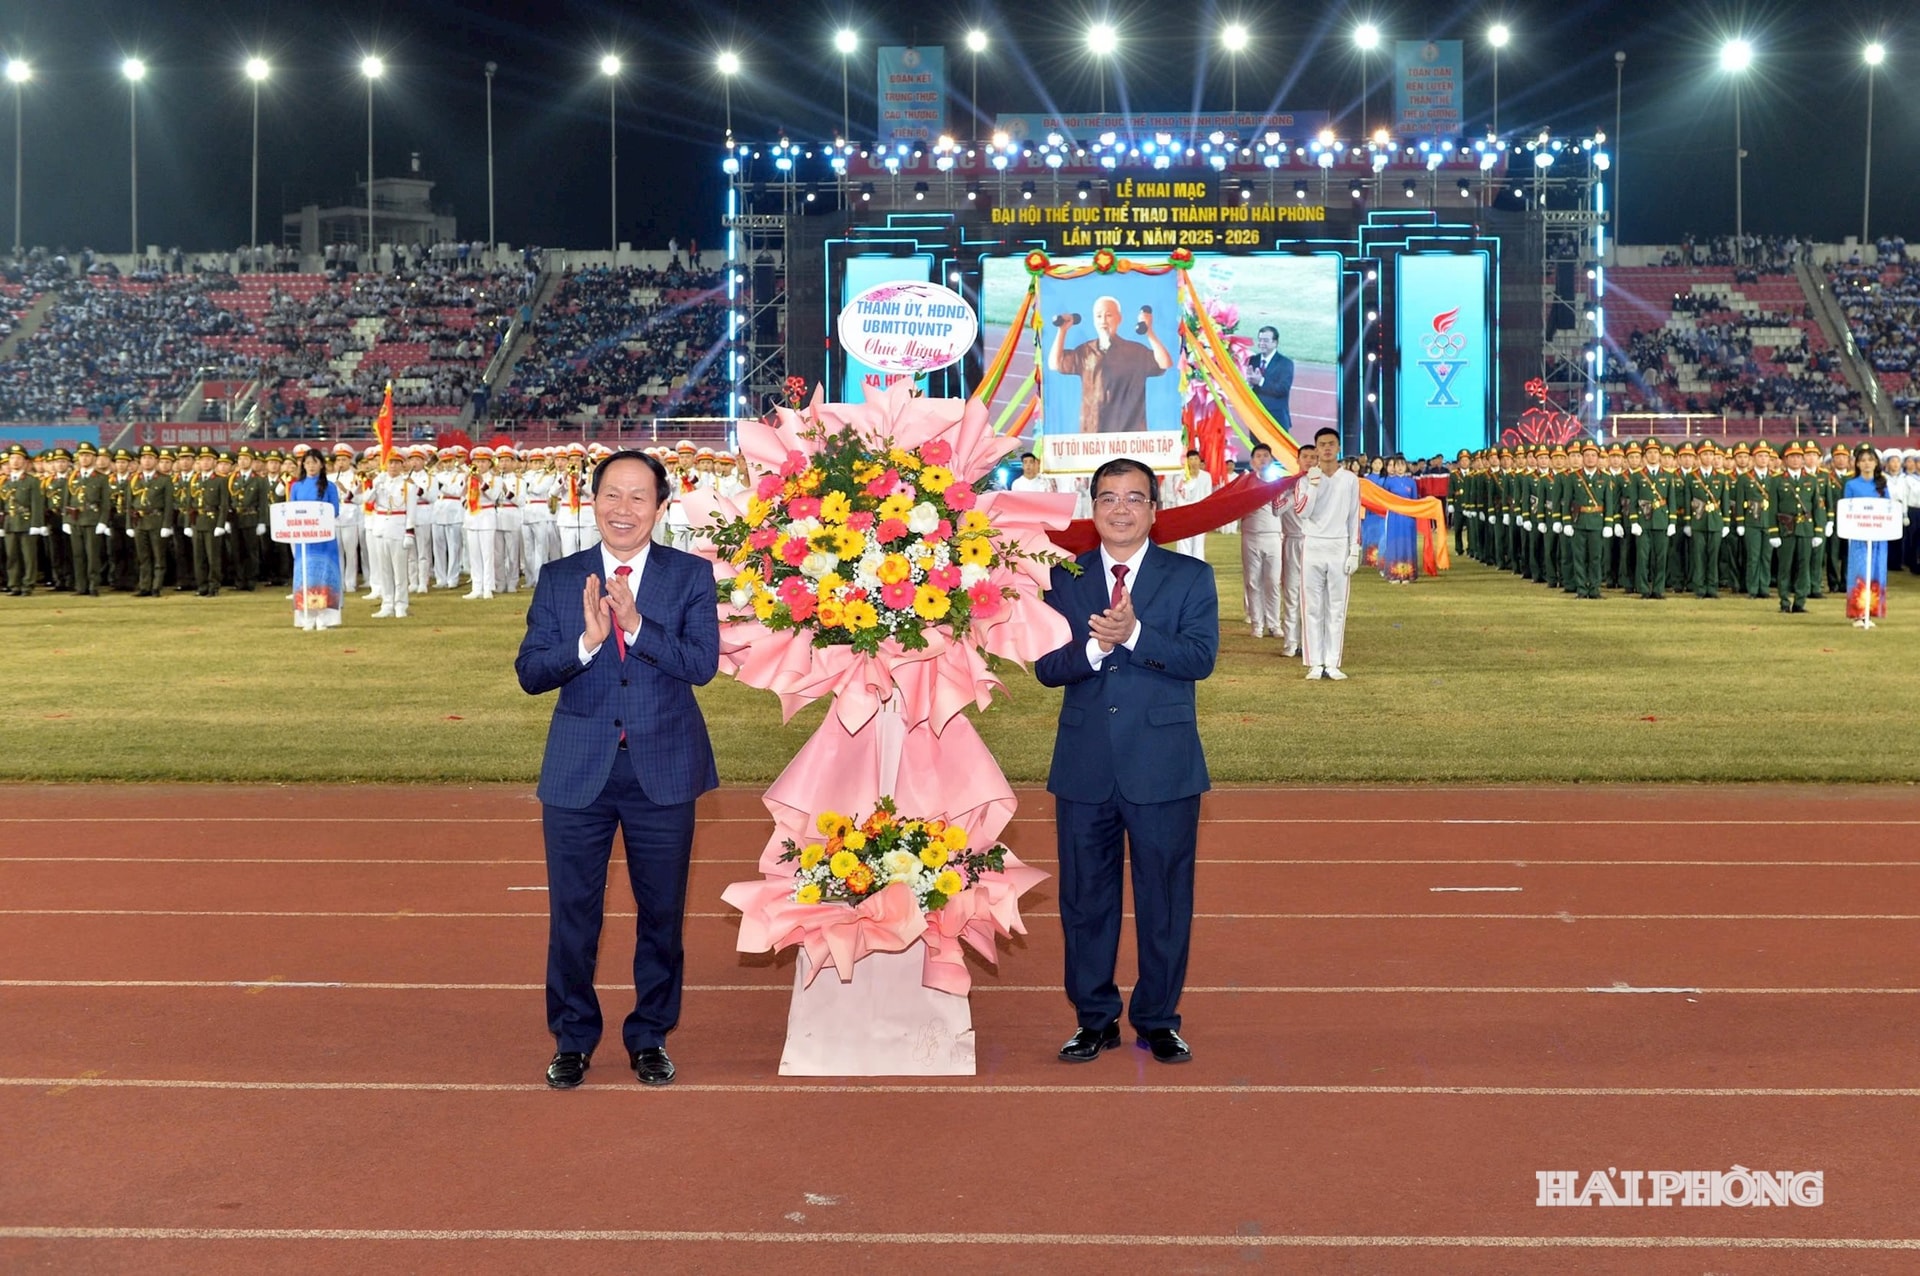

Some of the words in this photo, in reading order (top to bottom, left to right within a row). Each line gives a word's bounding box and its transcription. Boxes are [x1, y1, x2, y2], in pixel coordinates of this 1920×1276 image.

[1116, 178, 1133, 198] LỄ
[1136, 183, 1170, 198] KHAI
[1174, 183, 1206, 201] MẠC
[991, 208, 1015, 226] ĐẠI
[1018, 204, 1041, 226] HỘI
[1045, 201, 1071, 223] THỂ
[1072, 208, 1100, 226] DỤC
[1103, 200, 1130, 223] THỂ
[1132, 208, 1168, 223] THAO
[1171, 204, 1217, 223] THÀNH
[1220, 202, 1249, 222] PHỐ
[1251, 202, 1275, 222] HẢI
[1278, 203, 1325, 222] PHÒNG
[1062, 226, 1091, 246] LẦN
[1094, 226, 1123, 246] THỨ
[1125, 230, 1141, 247] X,
[1143, 227, 1177, 245] NĂM
[1179, 229, 1214, 245] 2025
[1225, 229, 1260, 245] 2026
[927, 303, 969, 321] HĐND,
[862, 319, 953, 337] UBMTTQVNTP
[864, 338, 898, 356] Chúc
[1052, 440, 1065, 459] TỰ
[1083, 437, 1106, 456] NGÀY
[1109, 437, 1127, 454] NÀO
[1157, 435, 1174, 456] TẬP
